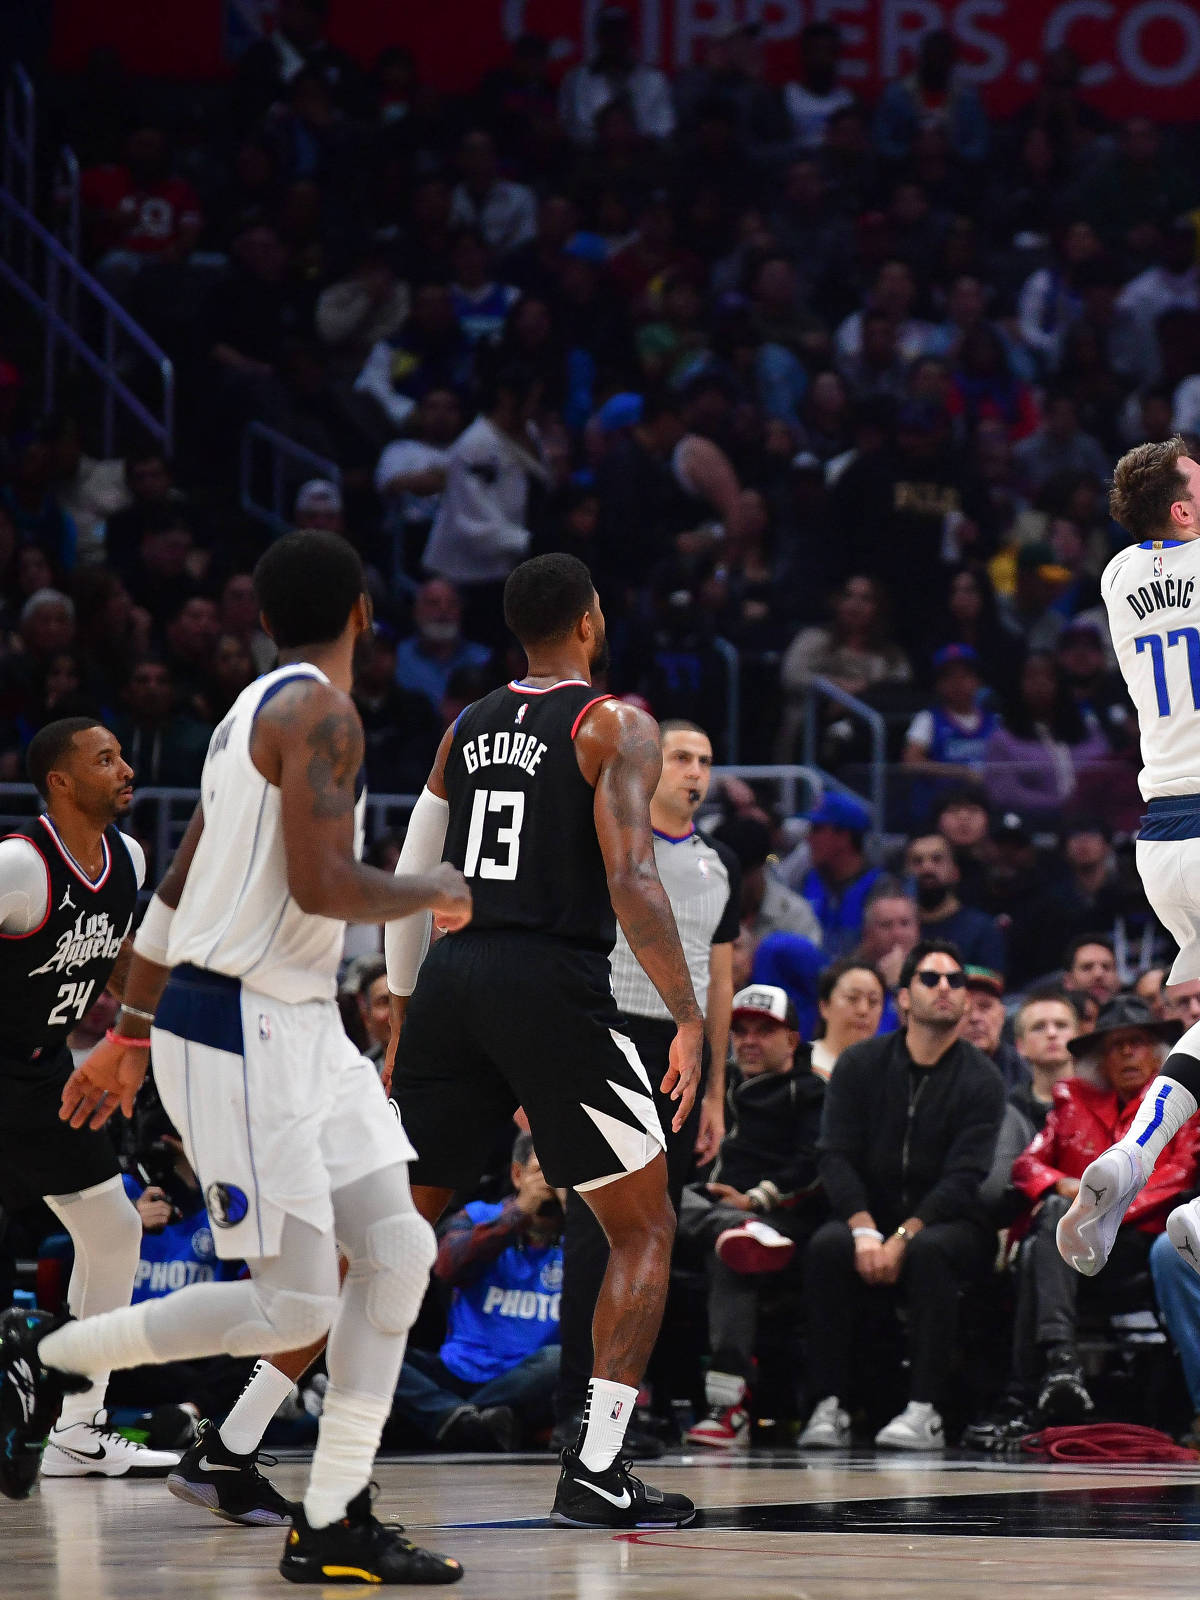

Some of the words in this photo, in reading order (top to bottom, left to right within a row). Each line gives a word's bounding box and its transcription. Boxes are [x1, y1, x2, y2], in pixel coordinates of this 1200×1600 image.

[1126, 573, 1196, 621] DONČIĆ
[462, 731, 548, 777] GEORGE
[463, 788, 526, 881] 13
[27, 911, 134, 977] Angeles
[73, 909, 110, 939] Los
[47, 978, 96, 1026] 24
[134, 1259, 215, 1292] PHOTO
